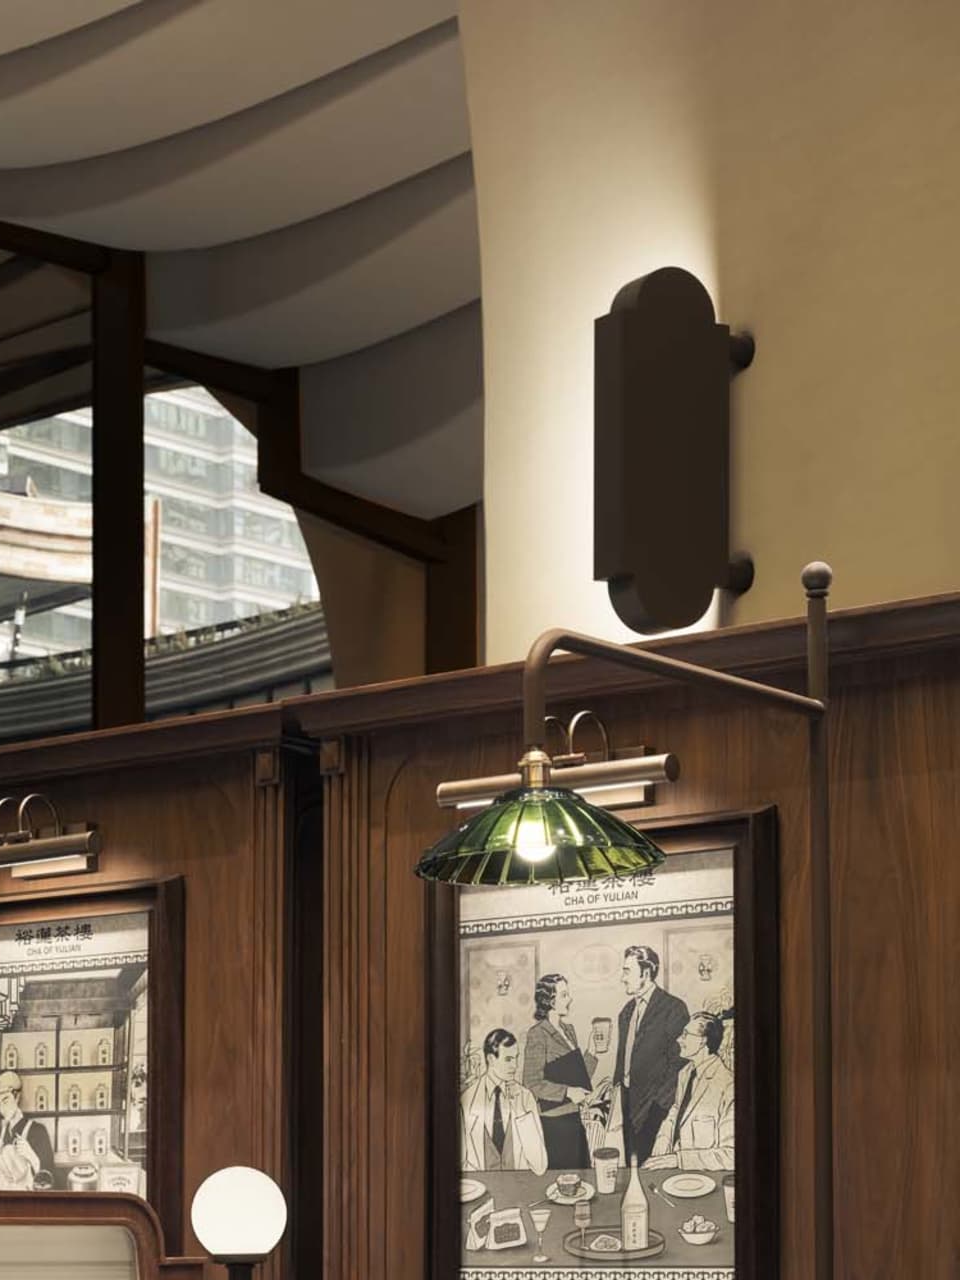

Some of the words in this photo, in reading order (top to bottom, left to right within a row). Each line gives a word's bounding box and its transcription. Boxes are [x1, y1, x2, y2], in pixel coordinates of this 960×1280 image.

[564, 896, 585, 906] CHA
[587, 894, 600, 904] OF
[603, 891, 639, 902] YULIAN
